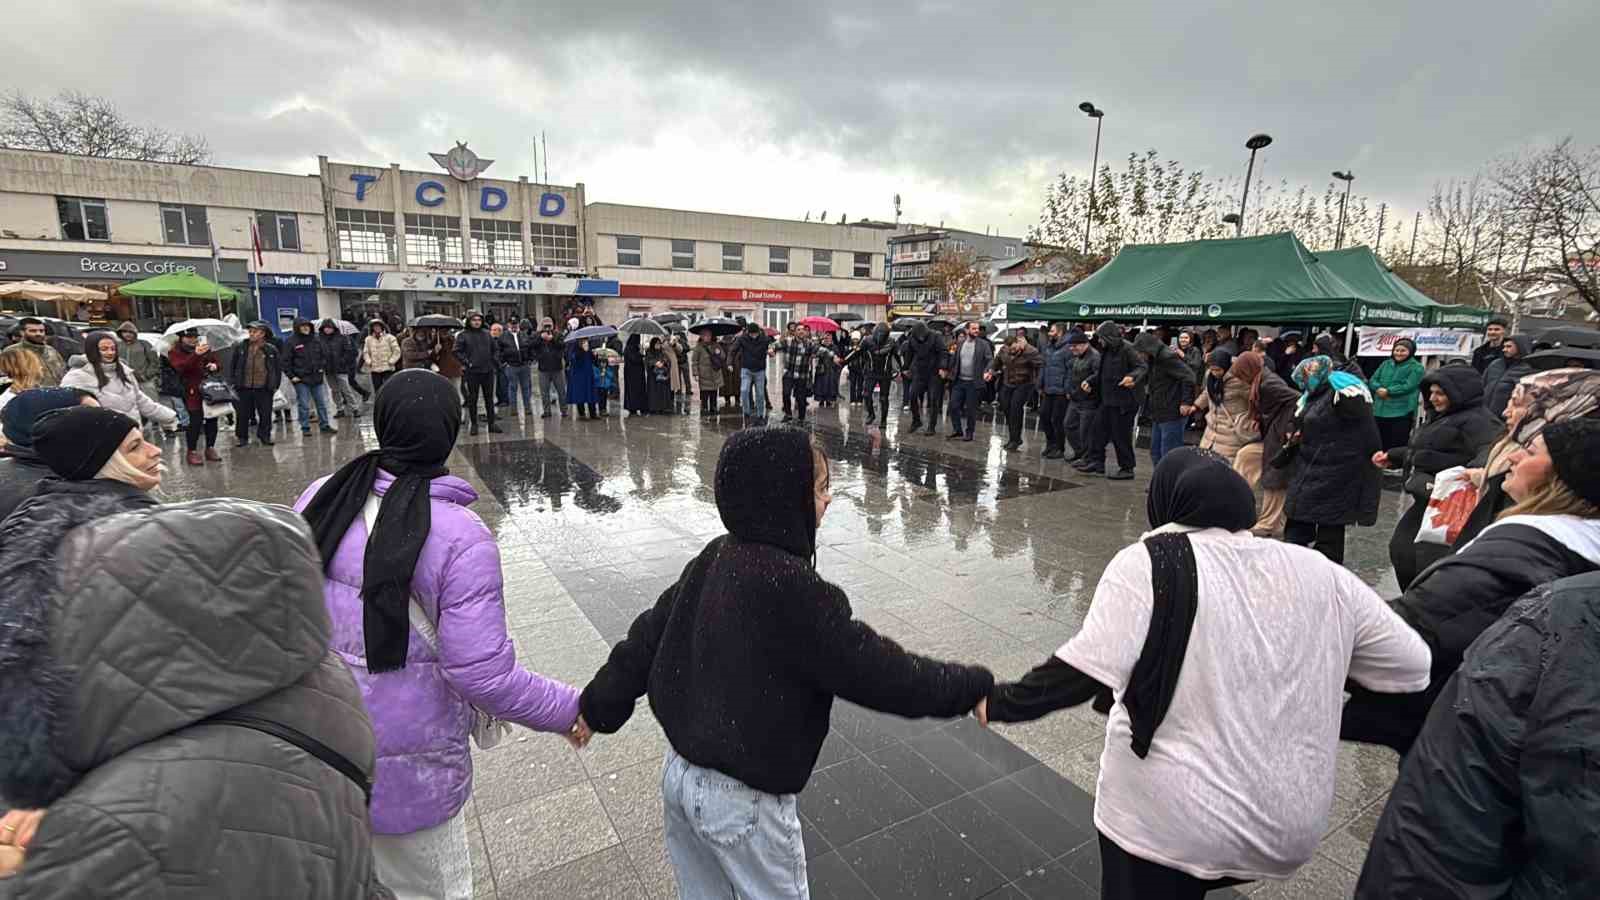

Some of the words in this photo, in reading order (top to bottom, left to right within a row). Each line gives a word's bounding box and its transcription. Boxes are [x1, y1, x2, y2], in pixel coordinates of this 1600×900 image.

[80, 257, 140, 275] Brezya
[144, 261, 196, 273] Coffee
[434, 276, 533, 290] ADAPAZARI
